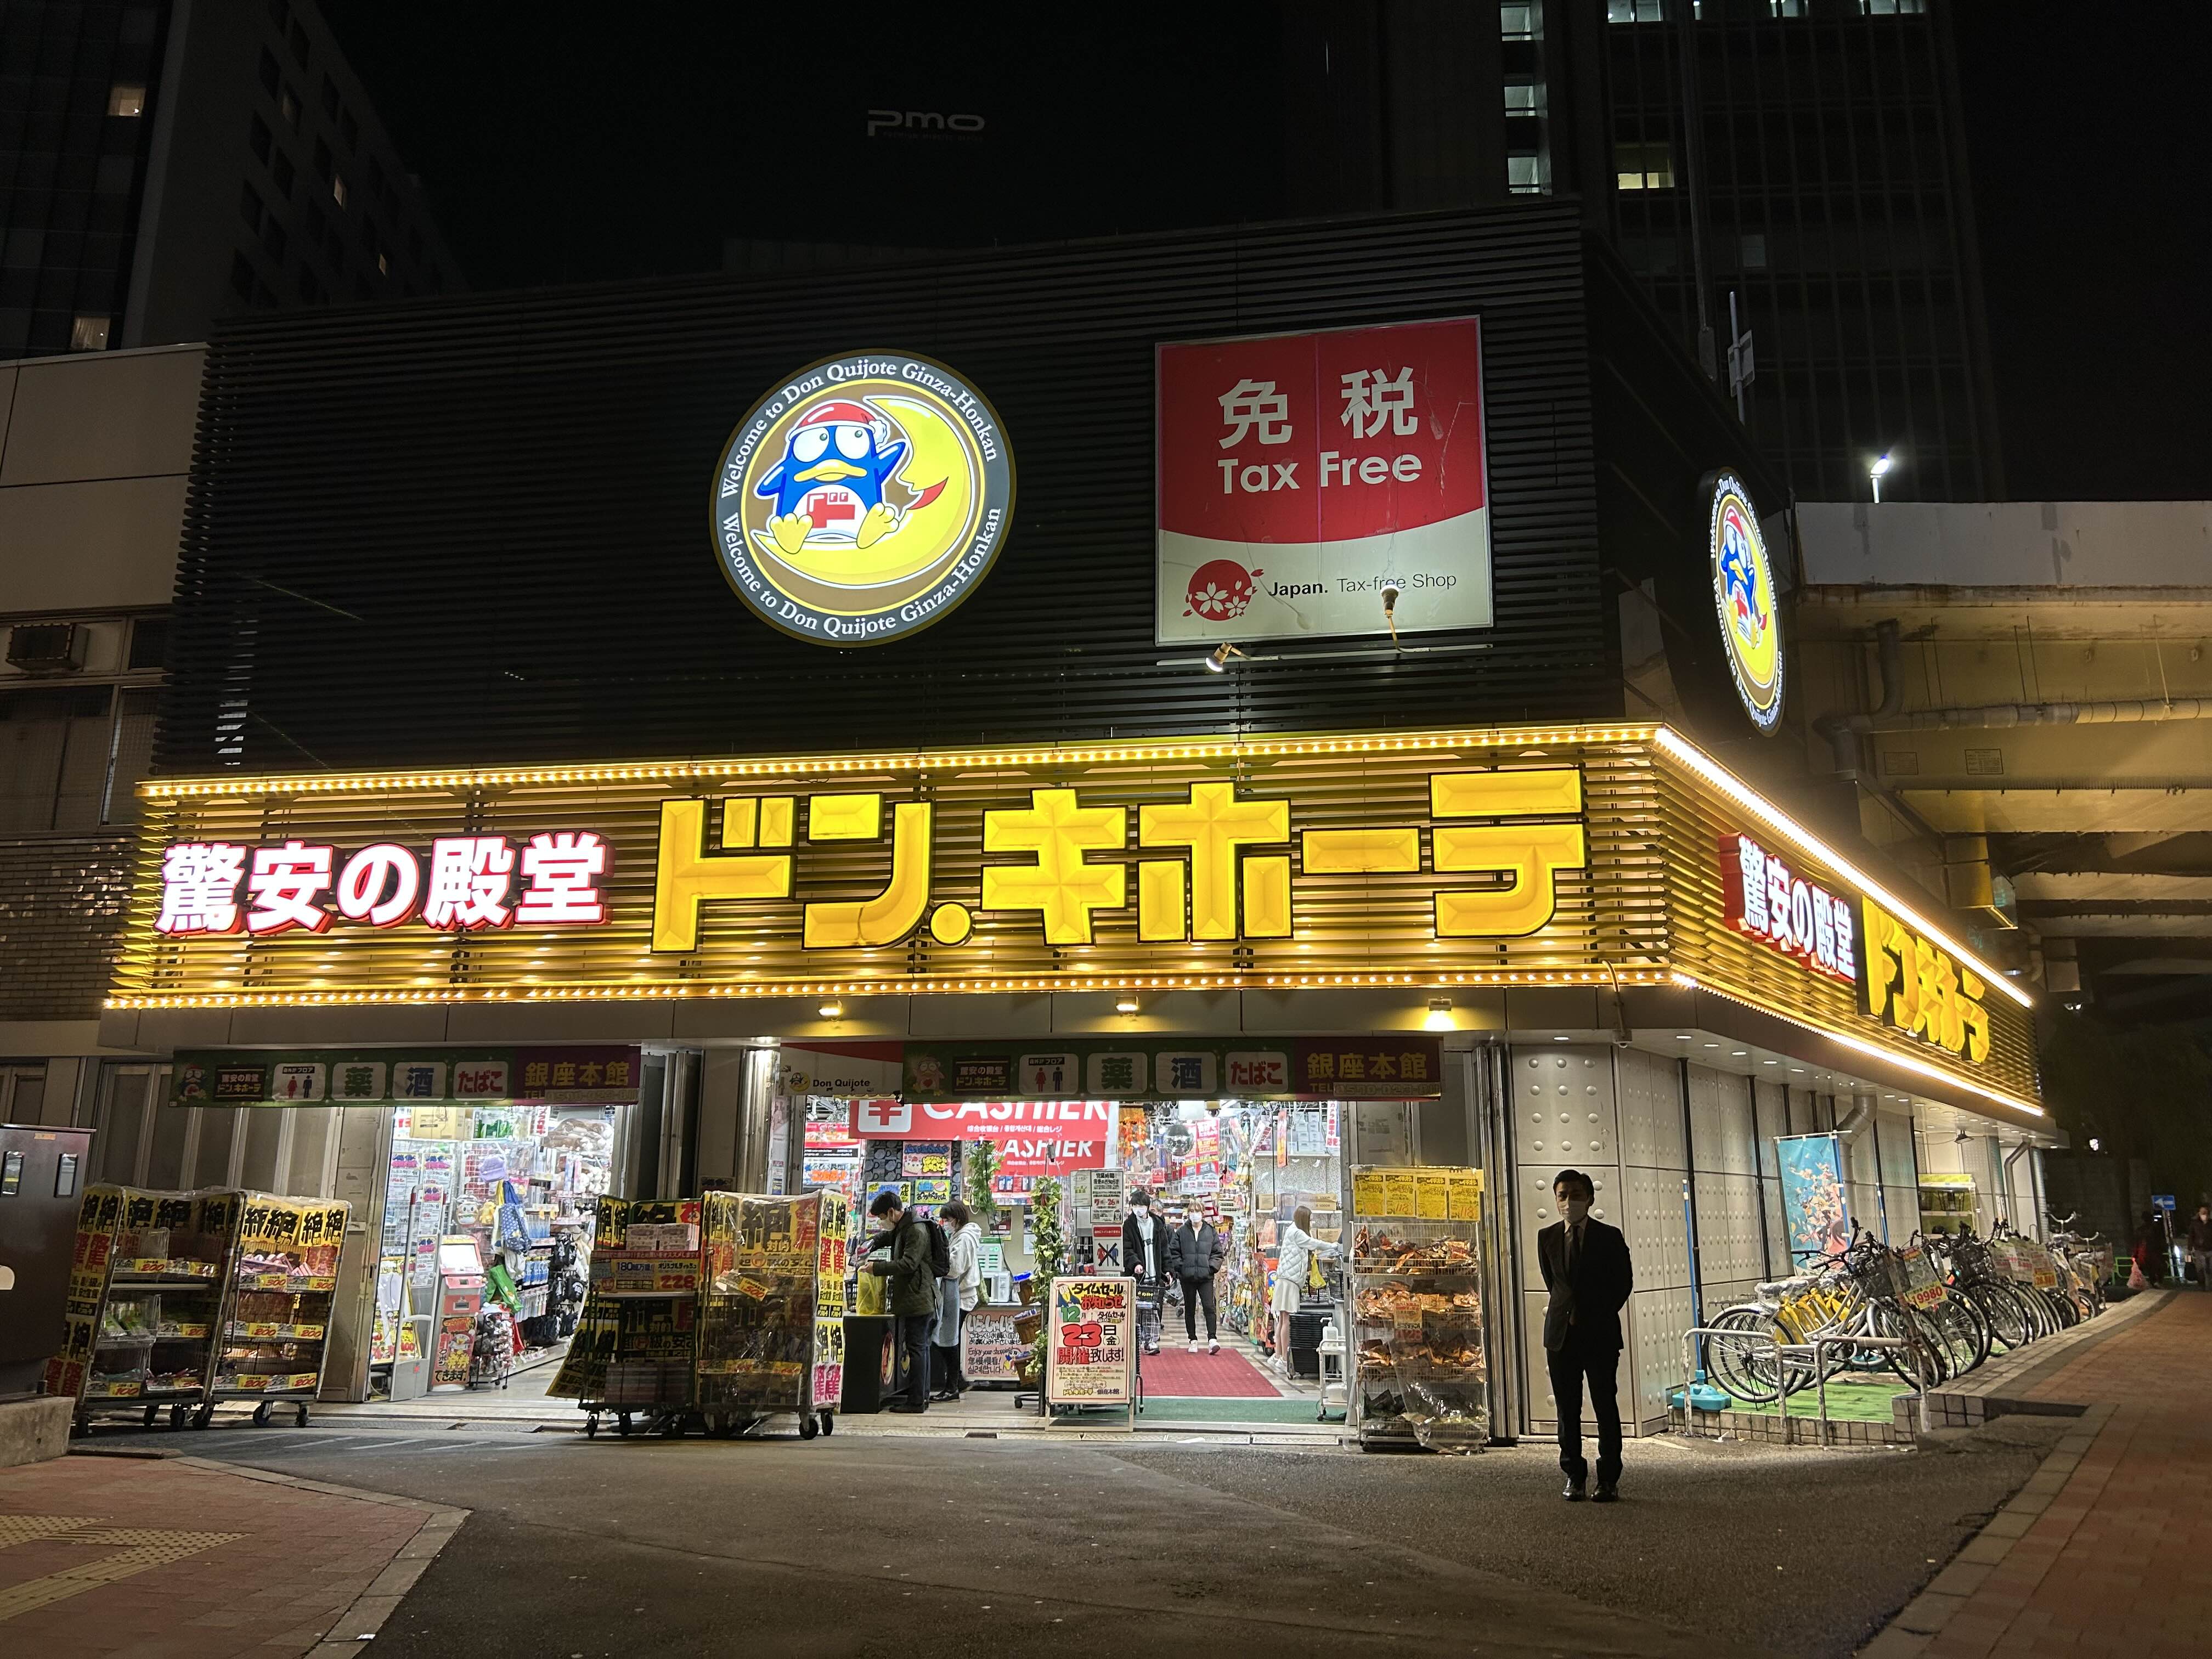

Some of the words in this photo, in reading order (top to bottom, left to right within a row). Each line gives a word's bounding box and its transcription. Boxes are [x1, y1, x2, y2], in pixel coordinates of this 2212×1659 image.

[721, 421, 767, 499] Welcome
[765, 402, 781, 418] to
[781, 375, 825, 404] Don
[826, 358, 897, 380] Quijote
[901, 363, 997, 462] Ginza-Honkan
[1217, 459, 1300, 494] Tax
[1320, 451, 1422, 487] Free
[722, 512, 766, 593] Welcome
[759, 590, 778, 608] to
[777, 600, 818, 630] Don
[823, 616, 896, 639] Quijote
[900, 507, 1001, 623] Ginza-Honkan
[1268, 582, 1328, 599] Japan.
[1413, 573, 1457, 590] Shop
[155, 831, 611, 935] 驚安の殿堂
[1738, 832, 1856, 983] 驚安の殿堂
[524, 1062, 630, 1087] 銀座本館
[1101, 1057, 1133, 1090] 薬
[1171, 1057, 1202, 1090] 酒
[1231, 1060, 1283, 1086] たばこ
[1307, 1052, 1427, 1080] 銀座本館
[344, 1066, 374, 1097] 薬
[405, 1067, 435, 1097] 酒
[458, 1070, 503, 1093] たばこ
[812, 1079, 832, 1087] Don
[834, 1079, 871, 1090] Quijote
[1310, 1083, 1334, 1093] TEL
[523, 1091, 544, 1099] TEL
[661, 1274, 696, 1289] 228
[1081, 1295, 1124, 1310] お知らせ
[1061, 1323, 1103, 1347] 23
[968, 1347, 983, 1356] Enjoy
[1057, 1347, 1124, 1365] 開催致します!
[294, 1378, 316, 1387] 200
